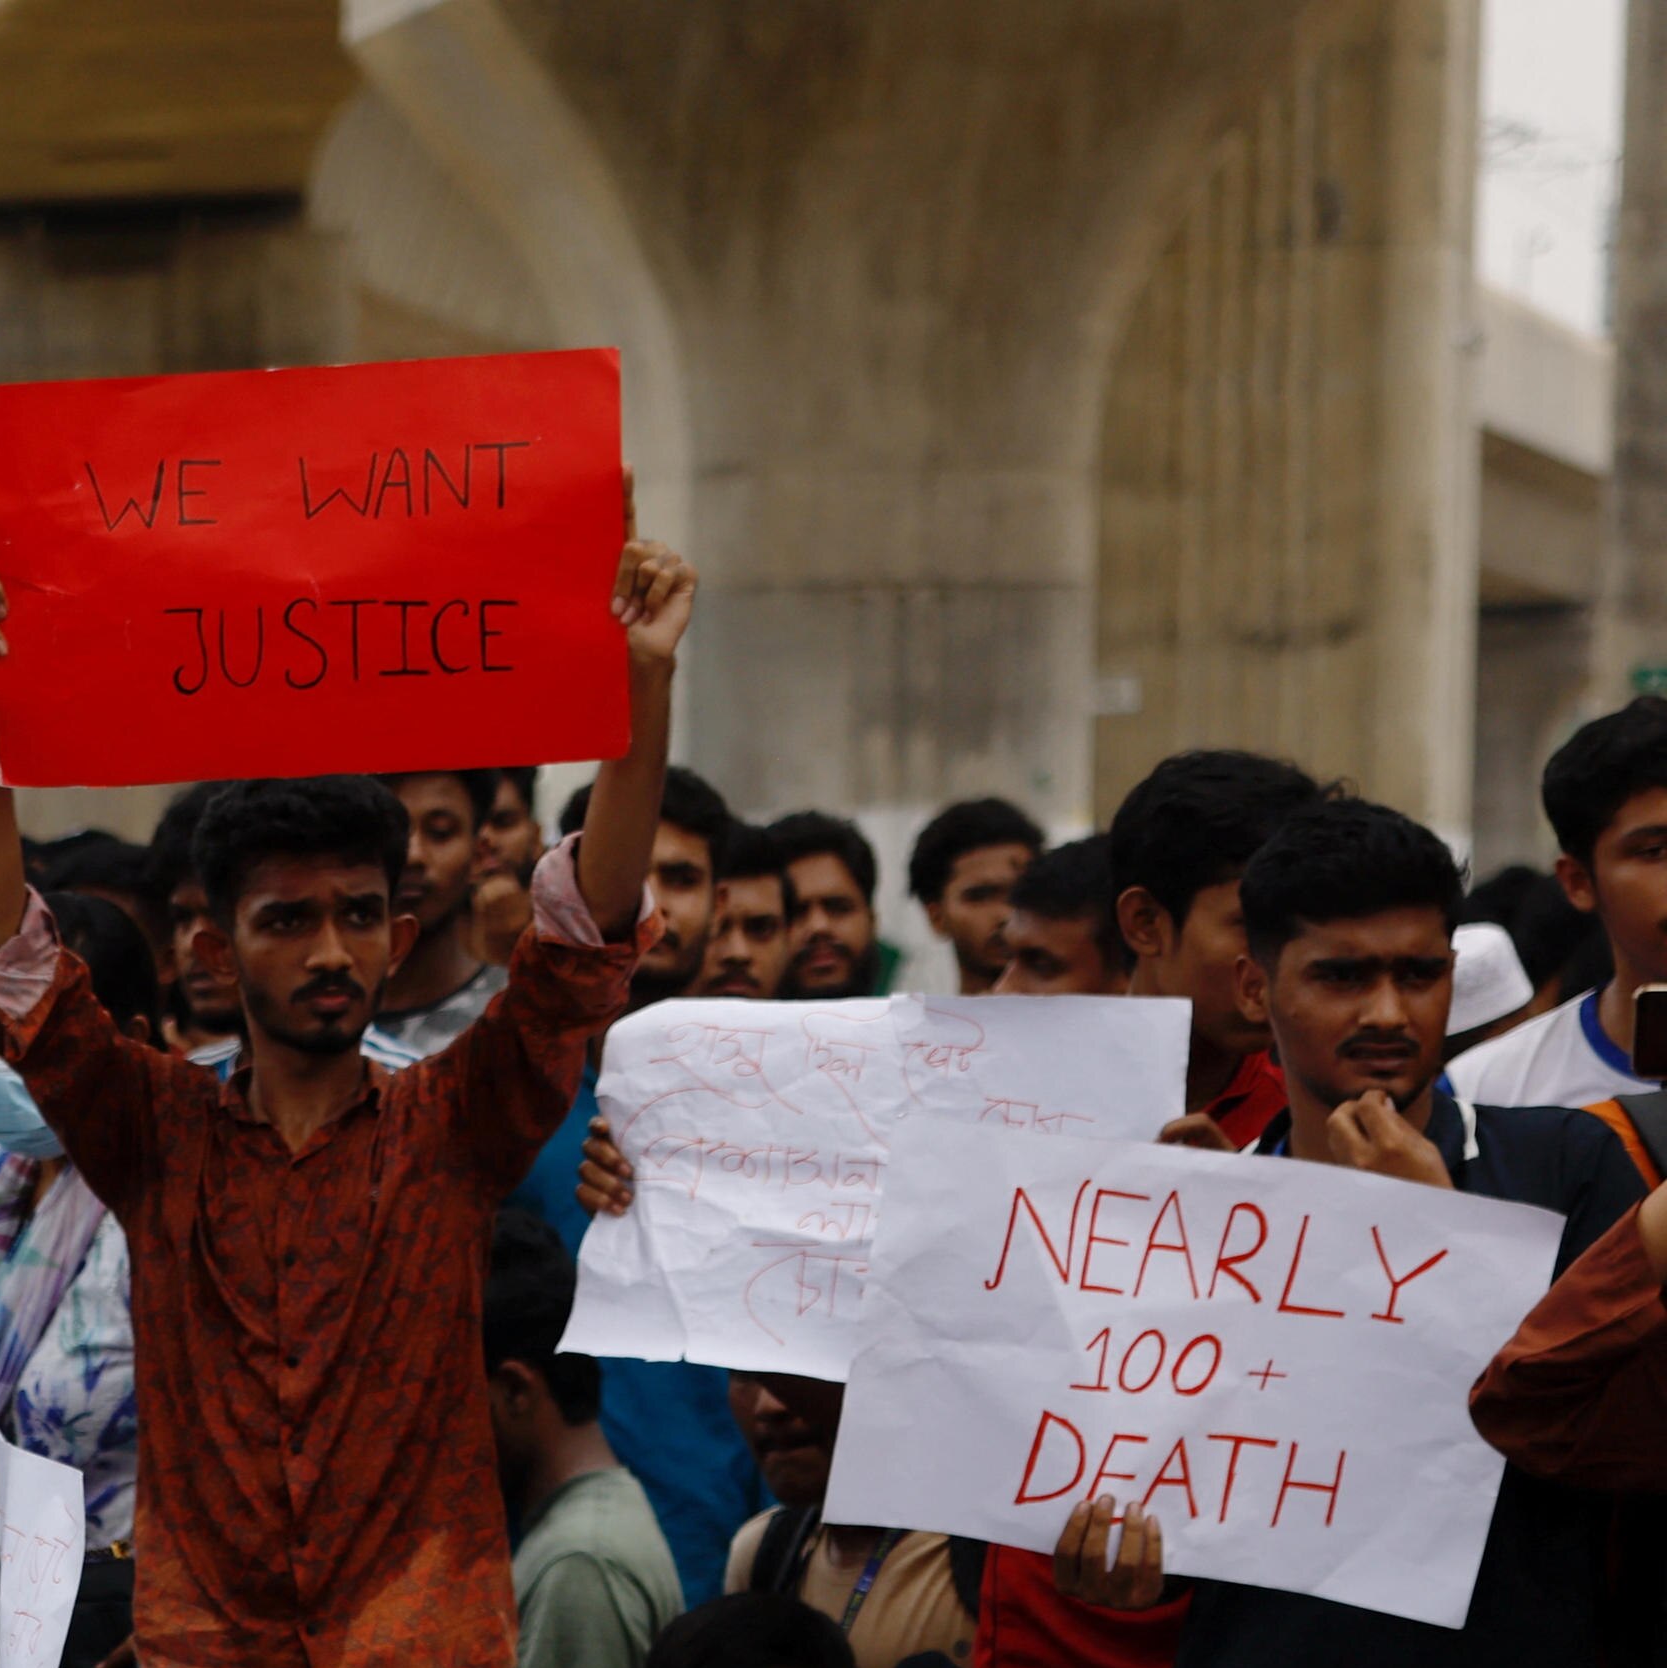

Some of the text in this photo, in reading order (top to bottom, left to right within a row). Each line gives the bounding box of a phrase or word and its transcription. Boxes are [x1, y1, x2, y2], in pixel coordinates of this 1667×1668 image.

[84, 441, 530, 533] WE WANT
[162, 597, 521, 696] JUSTICE
[984, 1179, 1450, 1324] NEARLY
[1014, 1409, 1347, 1530] DEATH
